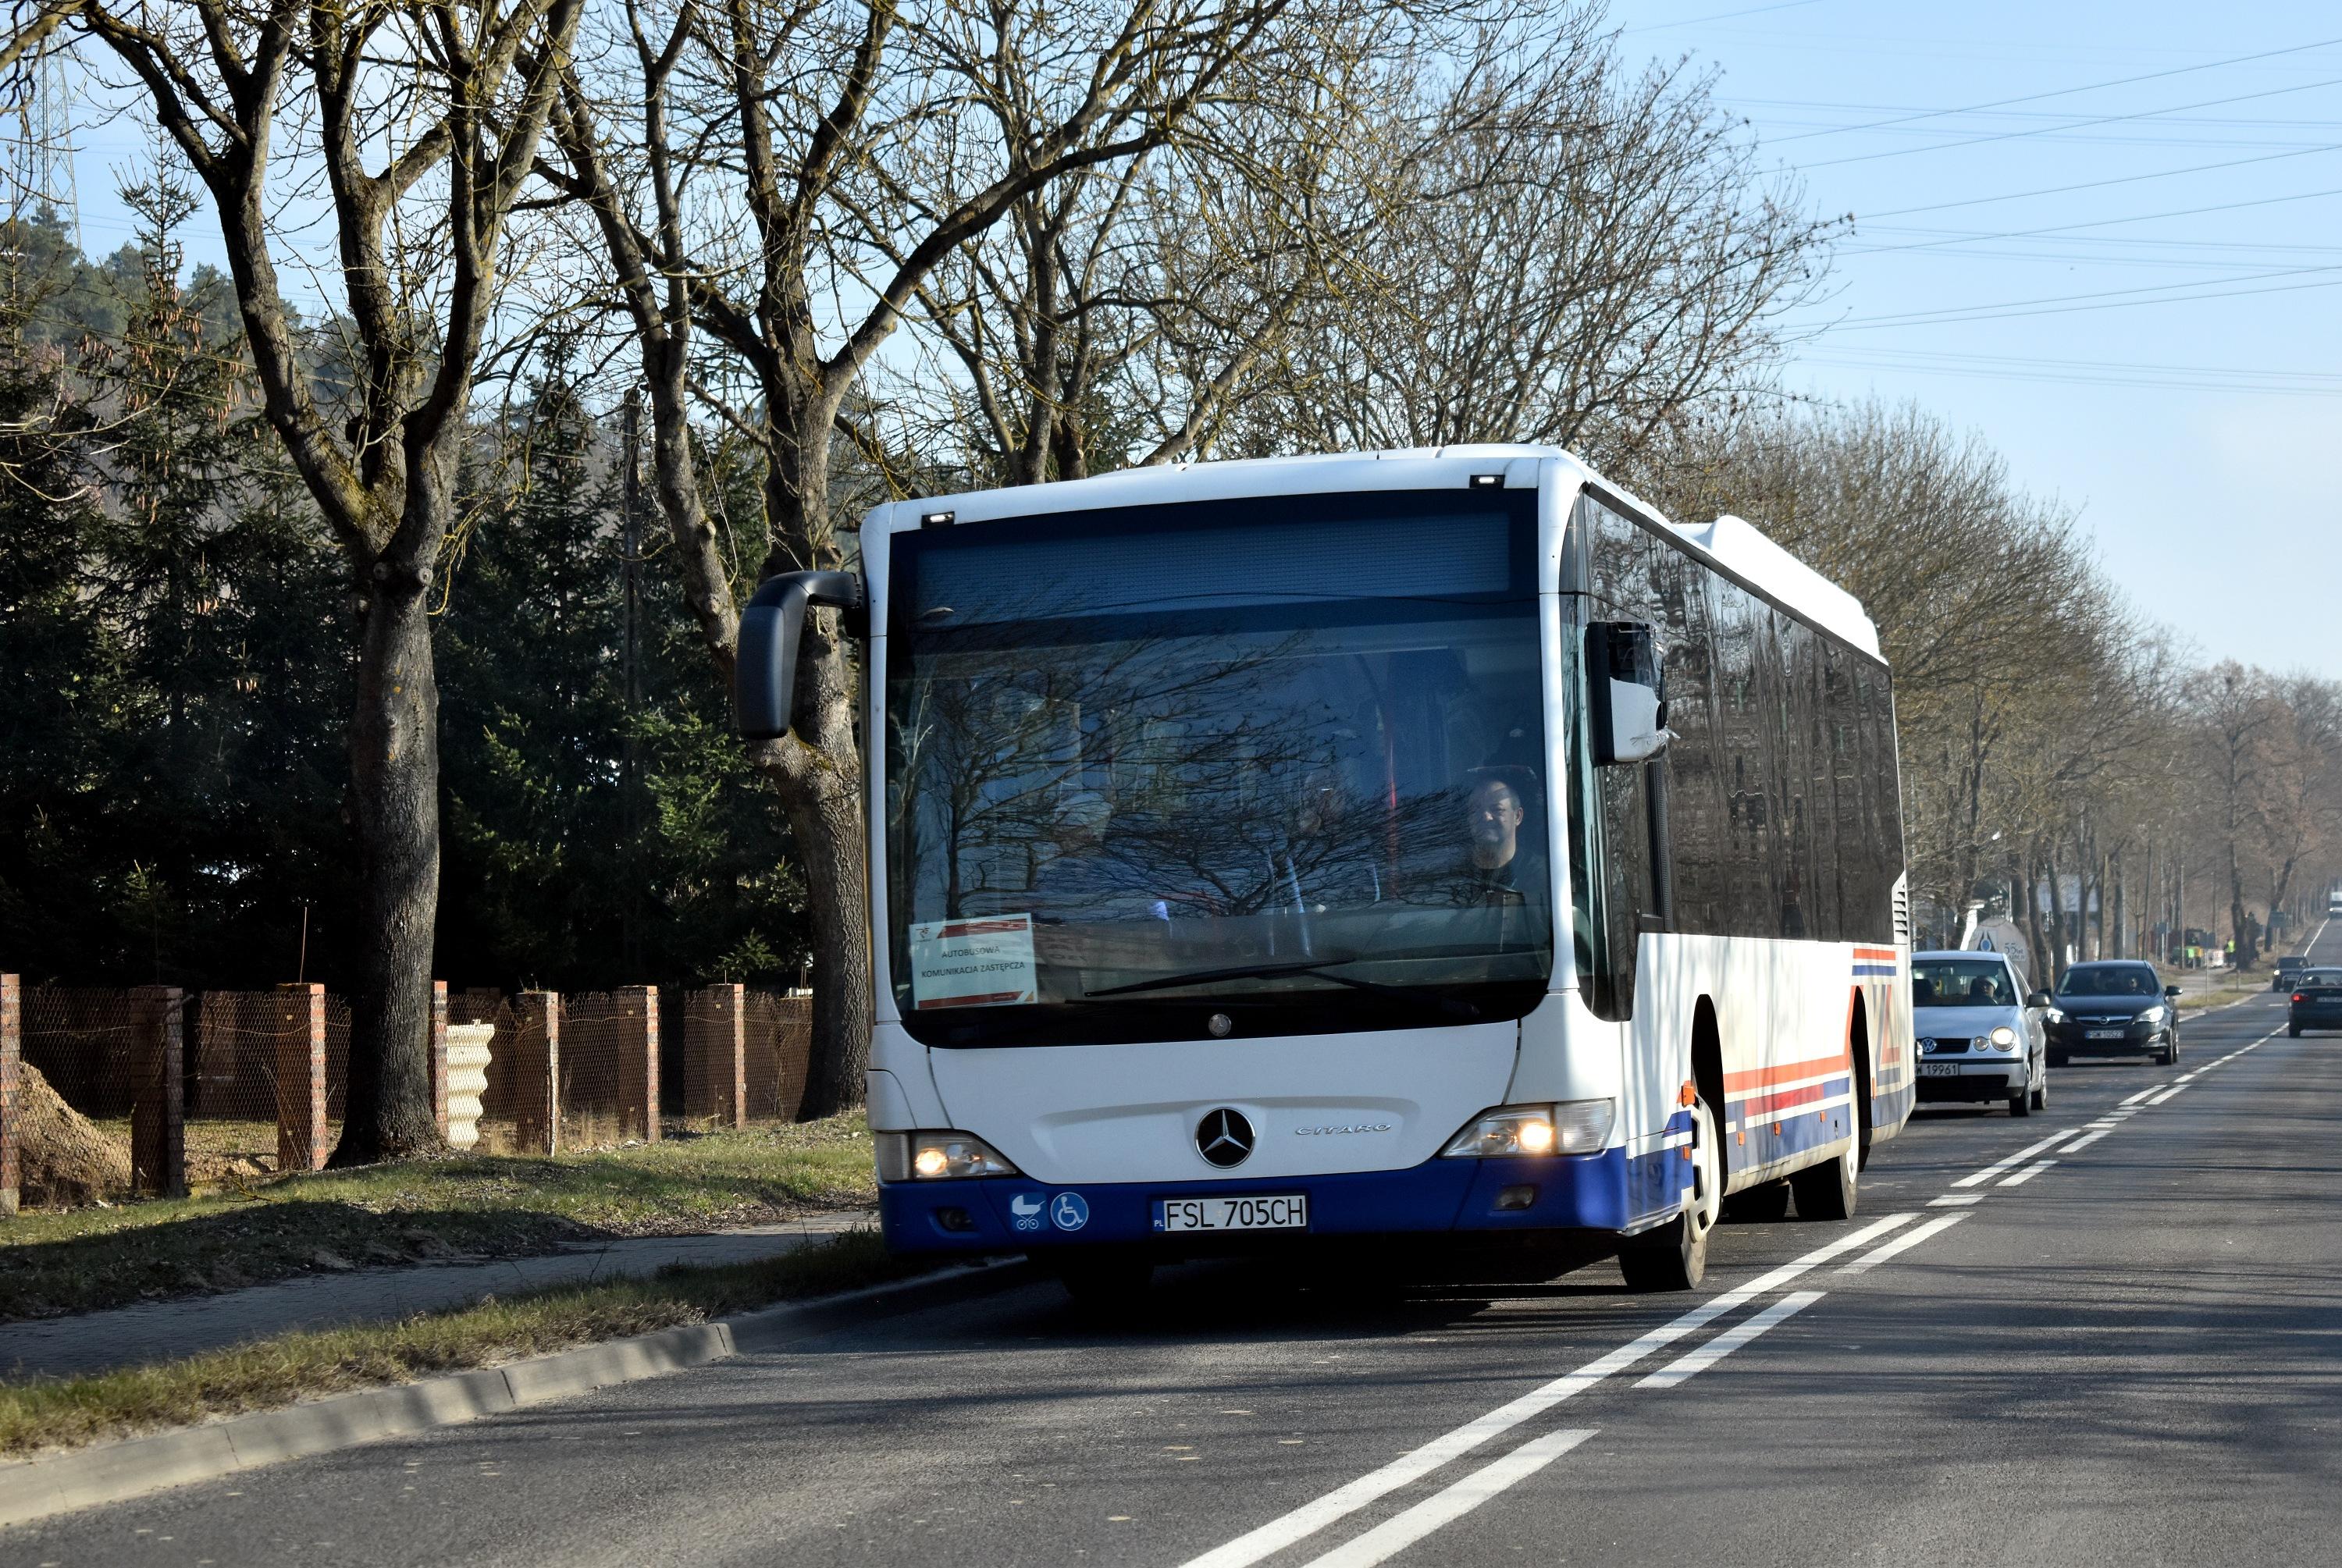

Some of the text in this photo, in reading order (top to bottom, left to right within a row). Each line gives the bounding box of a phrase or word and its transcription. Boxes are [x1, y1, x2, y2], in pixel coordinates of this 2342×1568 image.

[941, 946, 1001, 958] AUTOBUSOWA
[921, 962, 1025, 978] KOMUNIKACJA ZASTĘPCZA
[1927, 1065, 1956, 1075] 19961
[1295, 1123, 1392, 1136] CITARO
[1166, 1198, 1304, 1228] FSL 705CH
[1154, 1219, 1164, 1228] PL
